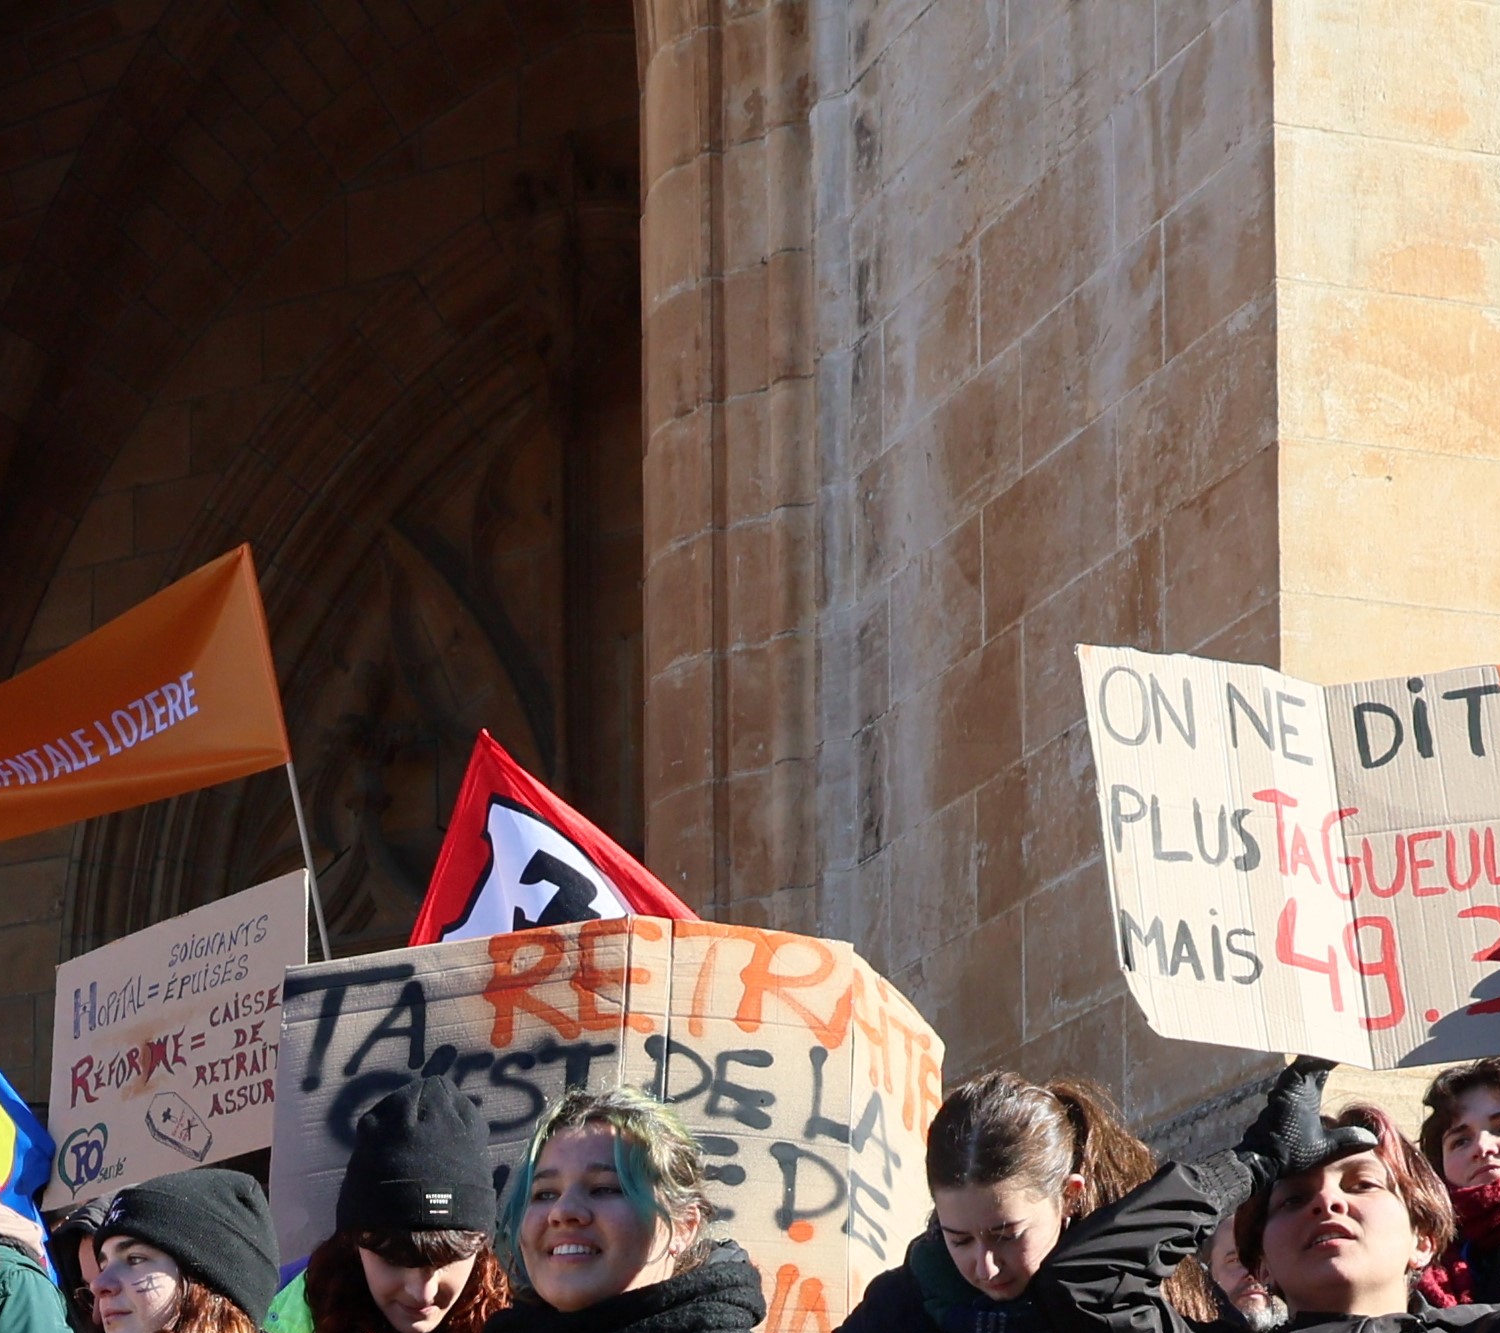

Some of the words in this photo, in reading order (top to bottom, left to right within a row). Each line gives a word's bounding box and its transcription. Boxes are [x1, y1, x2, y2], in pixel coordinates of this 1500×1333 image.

[94, 668, 201, 757] LOZERE
[1098, 665, 1198, 750] ON
[1224, 686, 1316, 766] NE
[1110, 783, 1262, 873] PLUS
[1251, 788, 1322, 886] TA
[231, 1020, 266, 1050] DE
[282, 963, 427, 1092] TA
[644, 1033, 776, 1130] DE
[804, 1045, 902, 1189] LA
